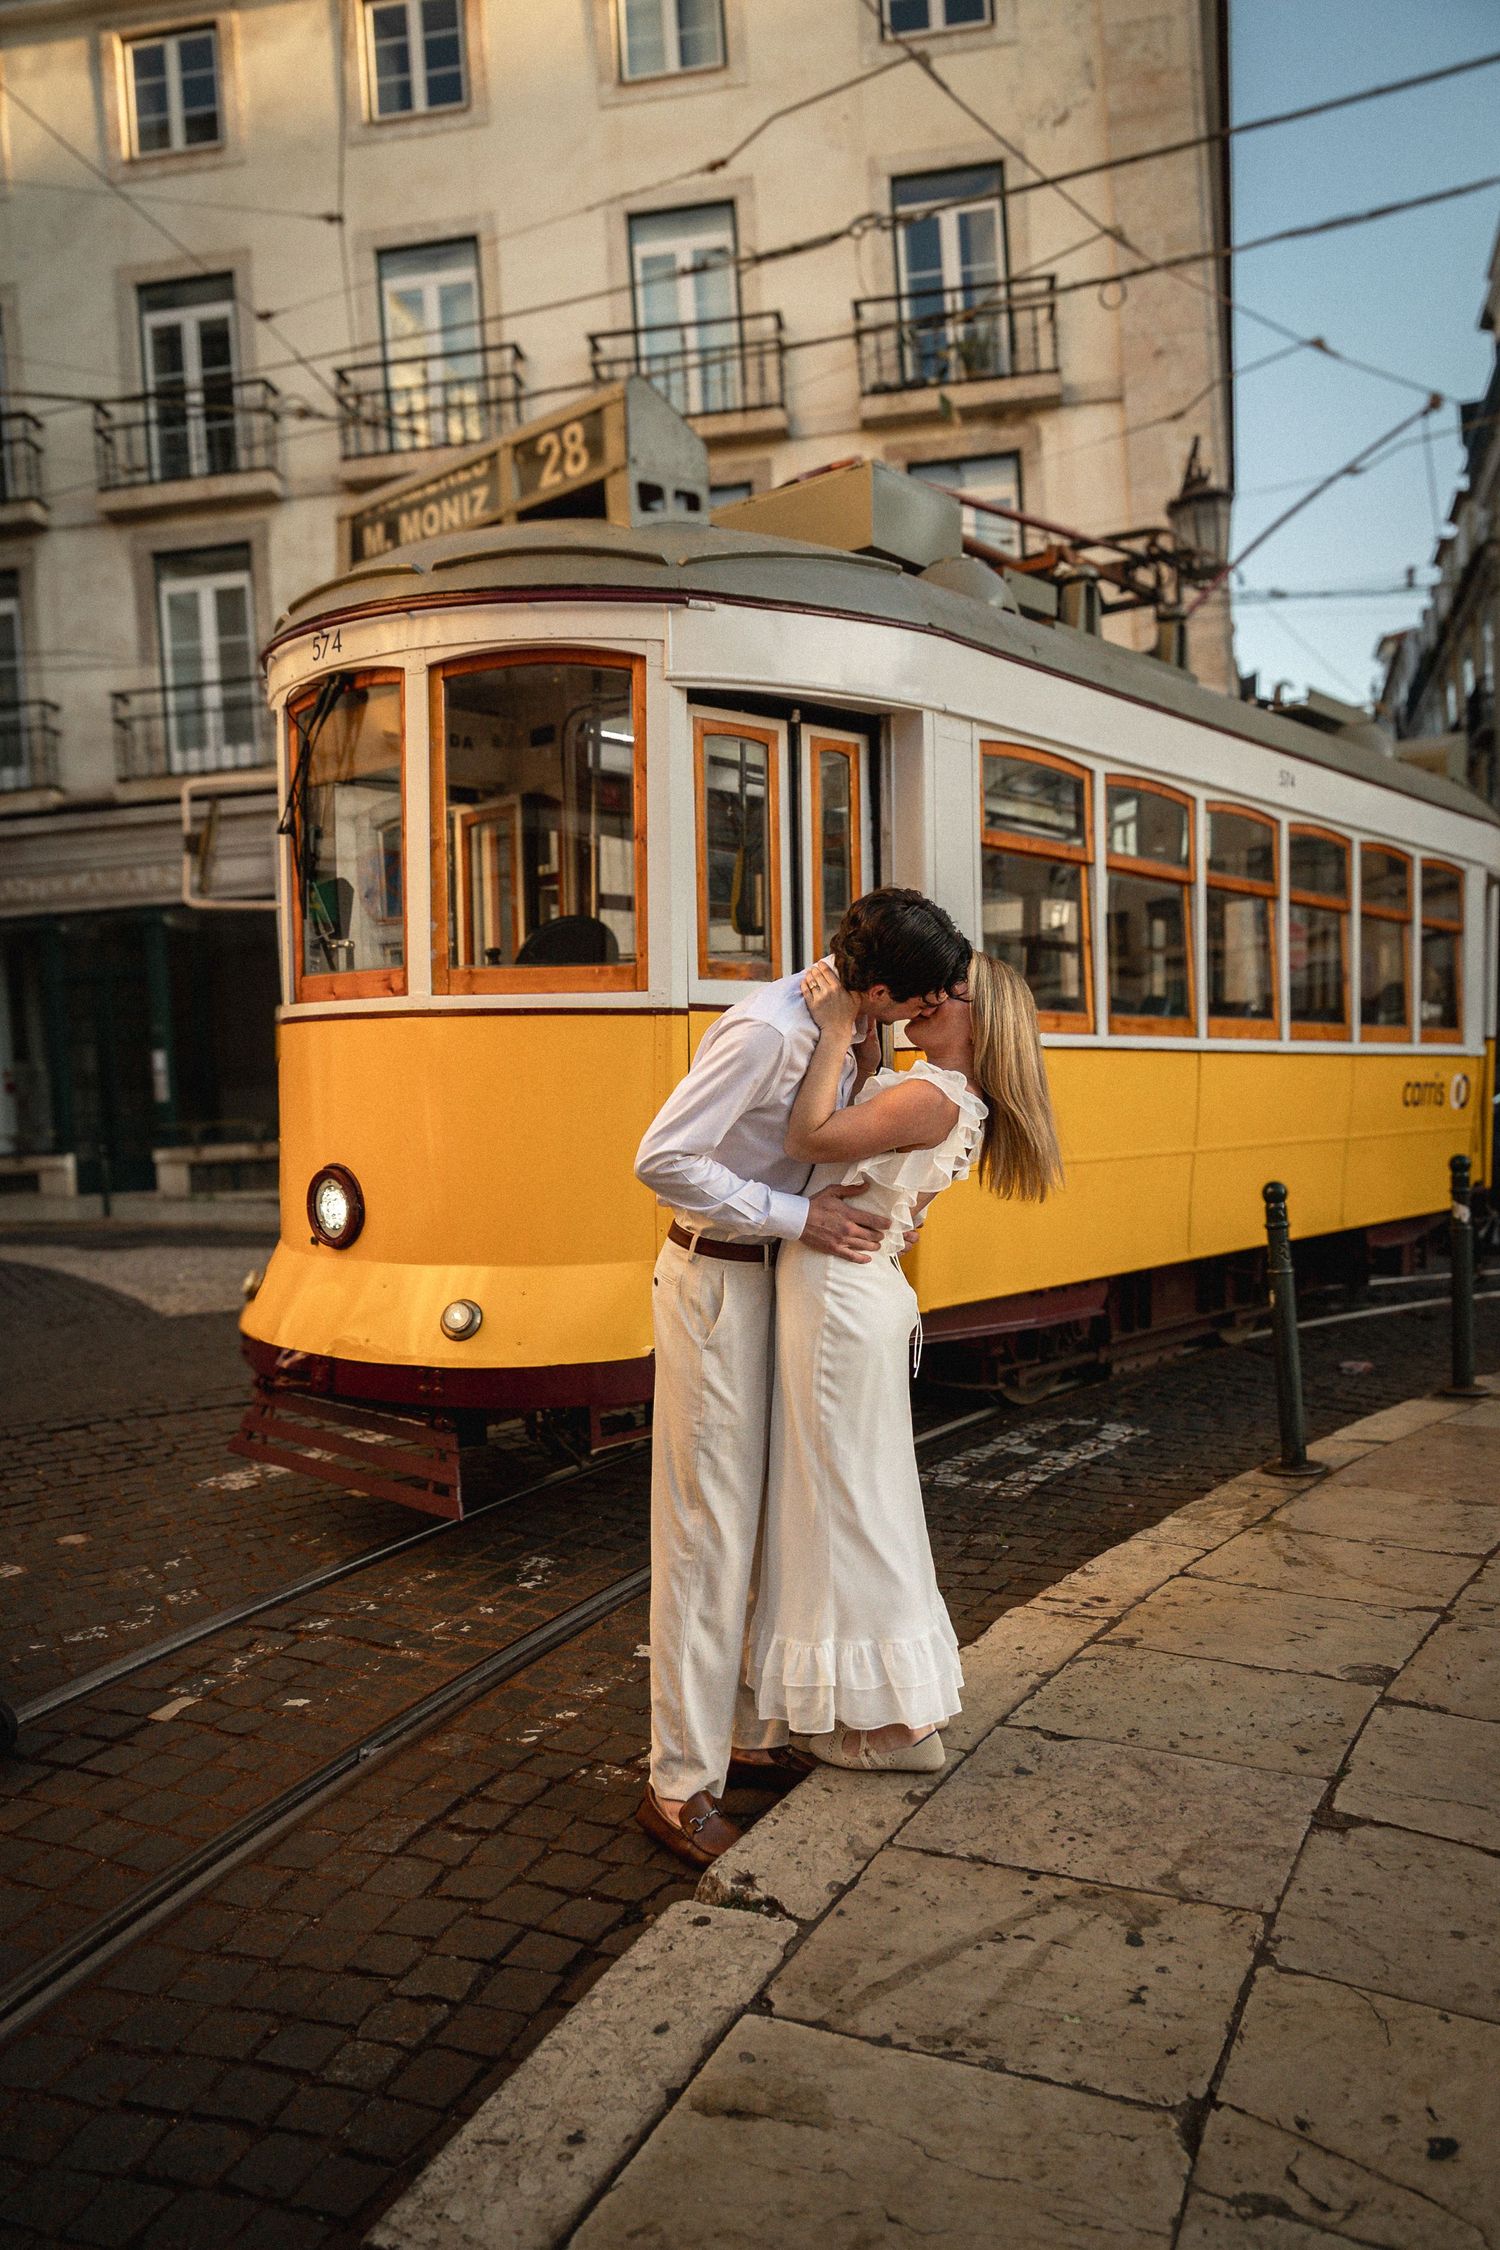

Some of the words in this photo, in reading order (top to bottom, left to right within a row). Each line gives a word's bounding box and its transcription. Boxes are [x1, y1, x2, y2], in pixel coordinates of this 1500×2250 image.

[536, 422, 590, 489] 28
[399, 485, 490, 547] MONIZ
[312, 628, 342, 661] 574
[1402, 1072, 1445, 1107] carris
